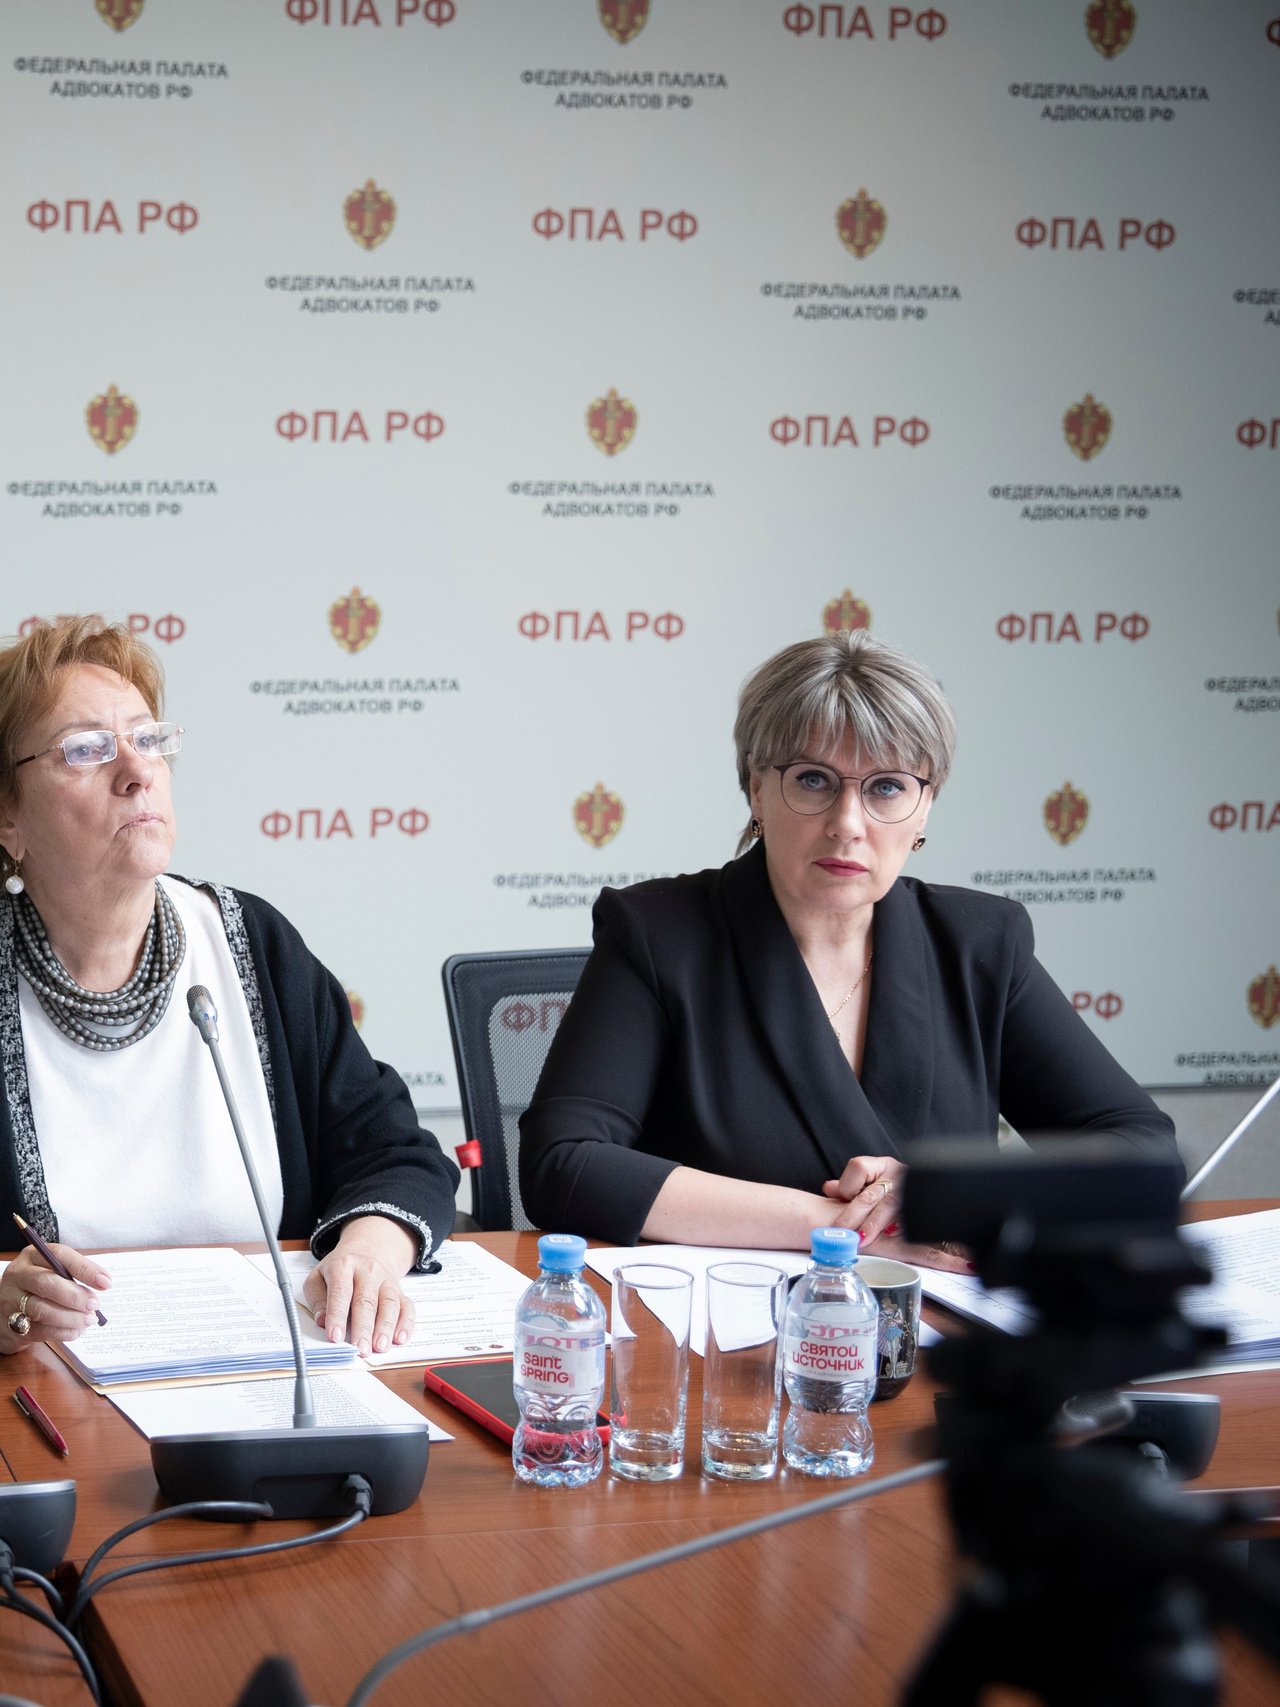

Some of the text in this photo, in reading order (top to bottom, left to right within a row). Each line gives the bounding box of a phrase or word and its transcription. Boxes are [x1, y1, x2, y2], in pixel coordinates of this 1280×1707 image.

[284, 0, 457, 28] ФПА РФ
[782, 2, 948, 42] ФПА РФ
[13, 56, 229, 78] ФЕДЕРАЛЬНАЯ ПАЛАТА
[520, 69, 727, 88] ФЕДЕРАЛЬНАЯ ПАЛАТА
[50, 80, 193, 99] АДВОКАТОВ РФ
[1008, 83, 1209, 101] ФЕДЕРАЛЬНАЯ ПАЛАТА
[555, 92, 693, 109] АДВОКАТОВ РФ
[1041, 105, 1175, 122] АДВОКАТОВ РФ
[26, 198, 200, 235] ФПА РФ
[531, 206, 699, 243] ФПА РФ
[1015, 216, 1176, 252] ФПА РФ
[265, 275, 475, 292] ФЕДЕРАЛЬНАЯ ПАЛАТА
[760, 282, 961, 300] ФЕДЕРАЛЬНАЯ ПАЛАТА
[299, 297, 440, 314] АДВОКАТОВ РФ
[793, 304, 927, 321] АДВОКАТОВ РФ
[274, 409, 446, 443] ФПА РФ
[769, 414, 931, 448] ФПА РФ
[6, 480, 218, 497] ФЕДЕРАЛЬНАЯ ПАЛАТА
[508, 481, 714, 497] ФЕДЕРАЛЬНАЯ ПАЛАТА
[989, 484, 1182, 501] ФЕДЕРАЛЬНАЯ ПАЛАТА
[42, 502, 182, 518] АДВОКАТОВ РФ
[542, 501, 680, 517] АДВОКАТОВ РФ
[1020, 505, 1149, 521] АДВОКАТОВ РФ
[517, 609, 686, 643] ФПА РФ
[995, 611, 1150, 644] ФПА РФ
[249, 678, 460, 695] ФЕДЕРАЛЬНАЯ ПАЛАТА
[283, 699, 424, 715] АДВОКАТОВ РФ
[259, 806, 431, 841] ФПА РФ
[493, 873, 630, 889] ФЕДЕРАЛЬНАЯ
[971, 868, 1157, 885] ФЕДЕРАЛЬНАЯ ПАЛАТА
[1100, 887, 1125, 902] РФ
[800, 1340, 858, 1358] СВЯТОЙ
[792, 1350, 865, 1371] ИСТОЧНИК
